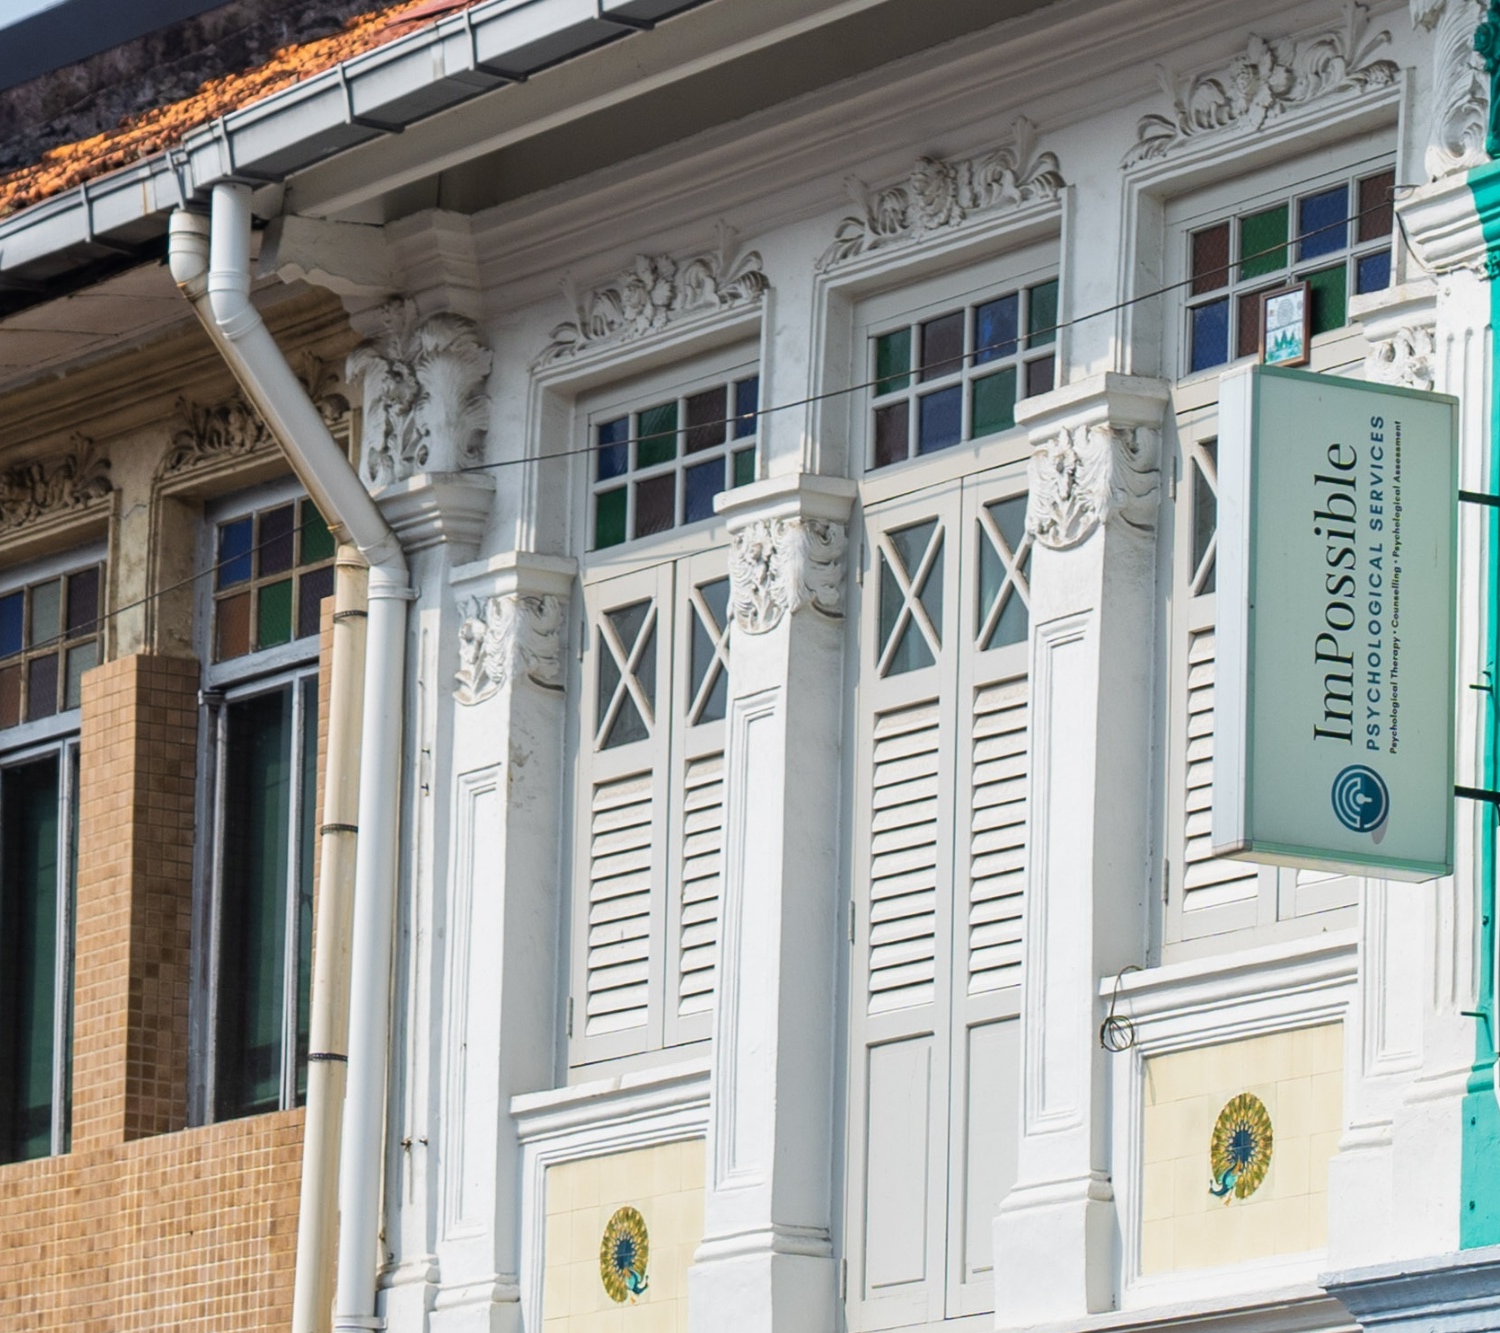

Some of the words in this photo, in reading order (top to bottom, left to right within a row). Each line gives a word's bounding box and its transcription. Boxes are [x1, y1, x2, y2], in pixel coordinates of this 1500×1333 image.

[1369, 415, 1385, 531] SERVICES
[1314, 442, 1357, 745] ImPossible
[1391, 567, 1401, 628] Counselling
[1366, 543, 1383, 751] PSYCHOLOGICAL
[1391, 637, 1400, 675] Therapy
[1388, 677, 1399, 755] Psychological
